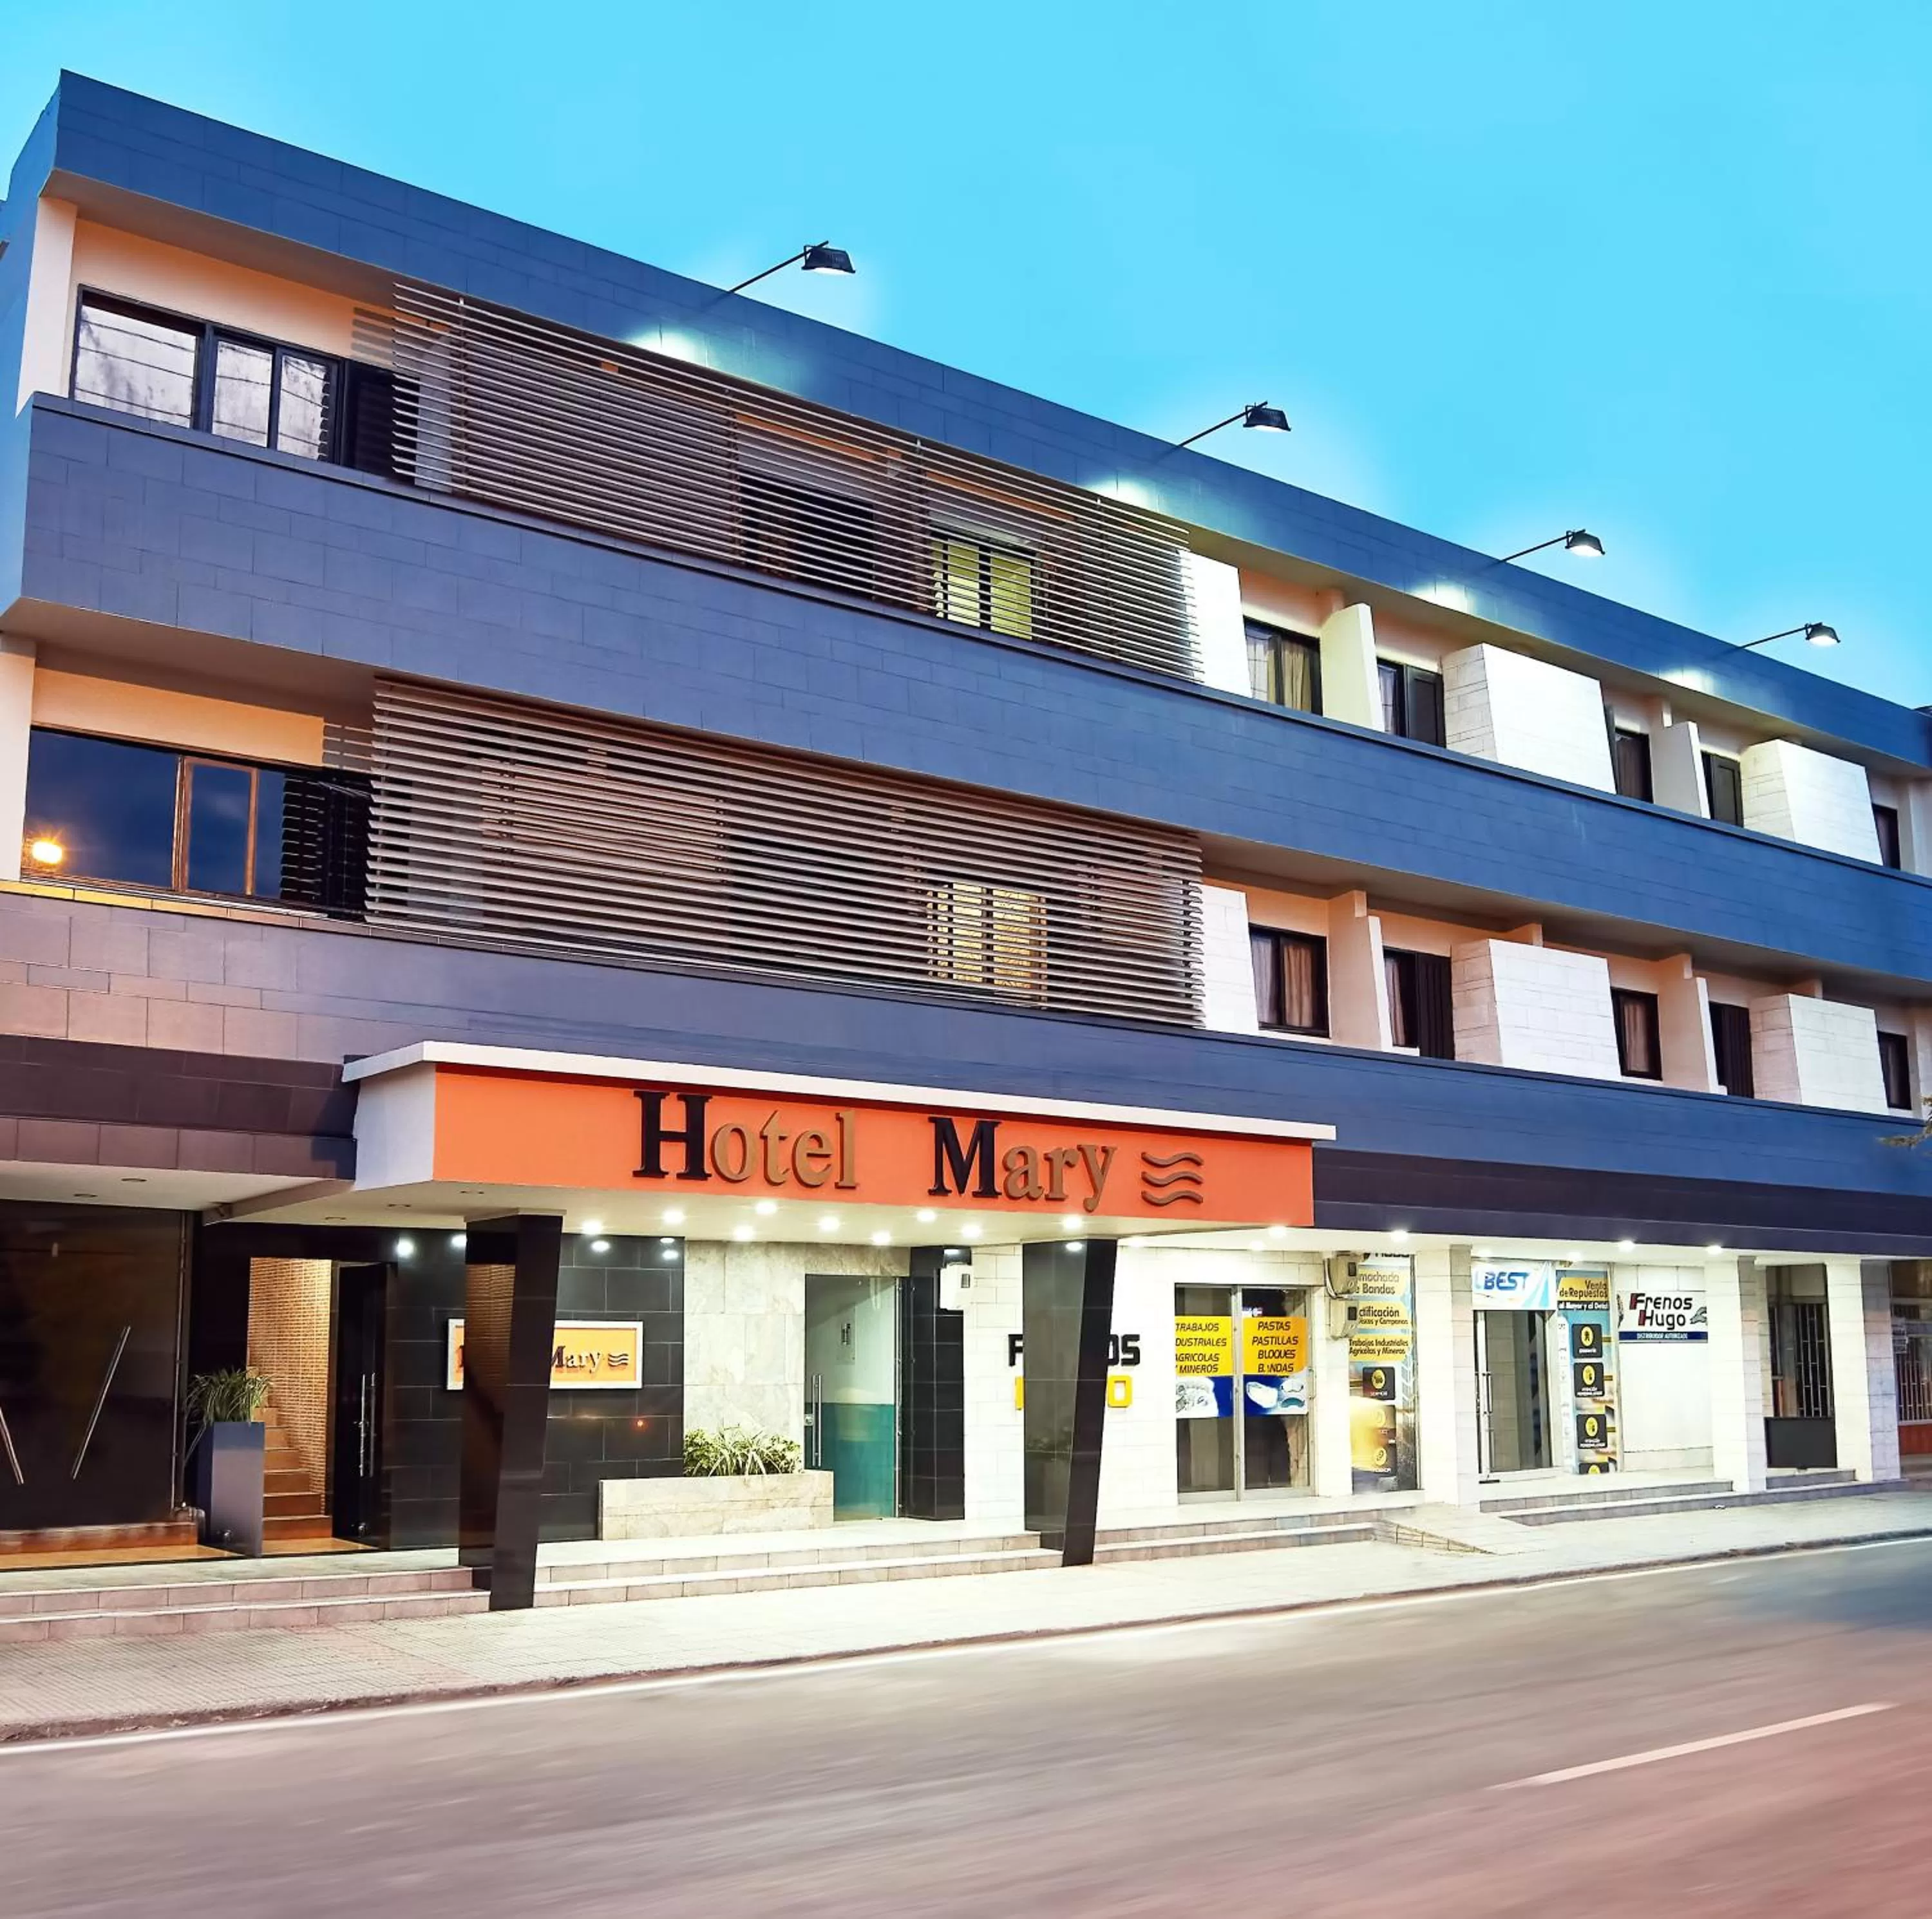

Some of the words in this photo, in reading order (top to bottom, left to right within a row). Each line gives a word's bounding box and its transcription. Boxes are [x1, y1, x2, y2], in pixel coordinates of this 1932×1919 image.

[632, 1090, 859, 1189] Hotel
[928, 1117, 1117, 1211] Mary
[1362, 1283, 1395, 1294] Bandas
[1629, 1292, 1693, 1310] Frenos
[1638, 1309, 1686, 1330] Hugo
[1175, 1322, 1219, 1332] TRABAJOS
[1258, 1321, 1291, 1330] PASTAS
[1175, 1338, 1227, 1347] DUSTRIALES
[1252, 1336, 1299, 1346] PASTILLAS
[1009, 1334, 1141, 1366] FOS
[1258, 1349, 1296, 1359] BLOQUES
[1179, 1364, 1218, 1374] MINEROS
